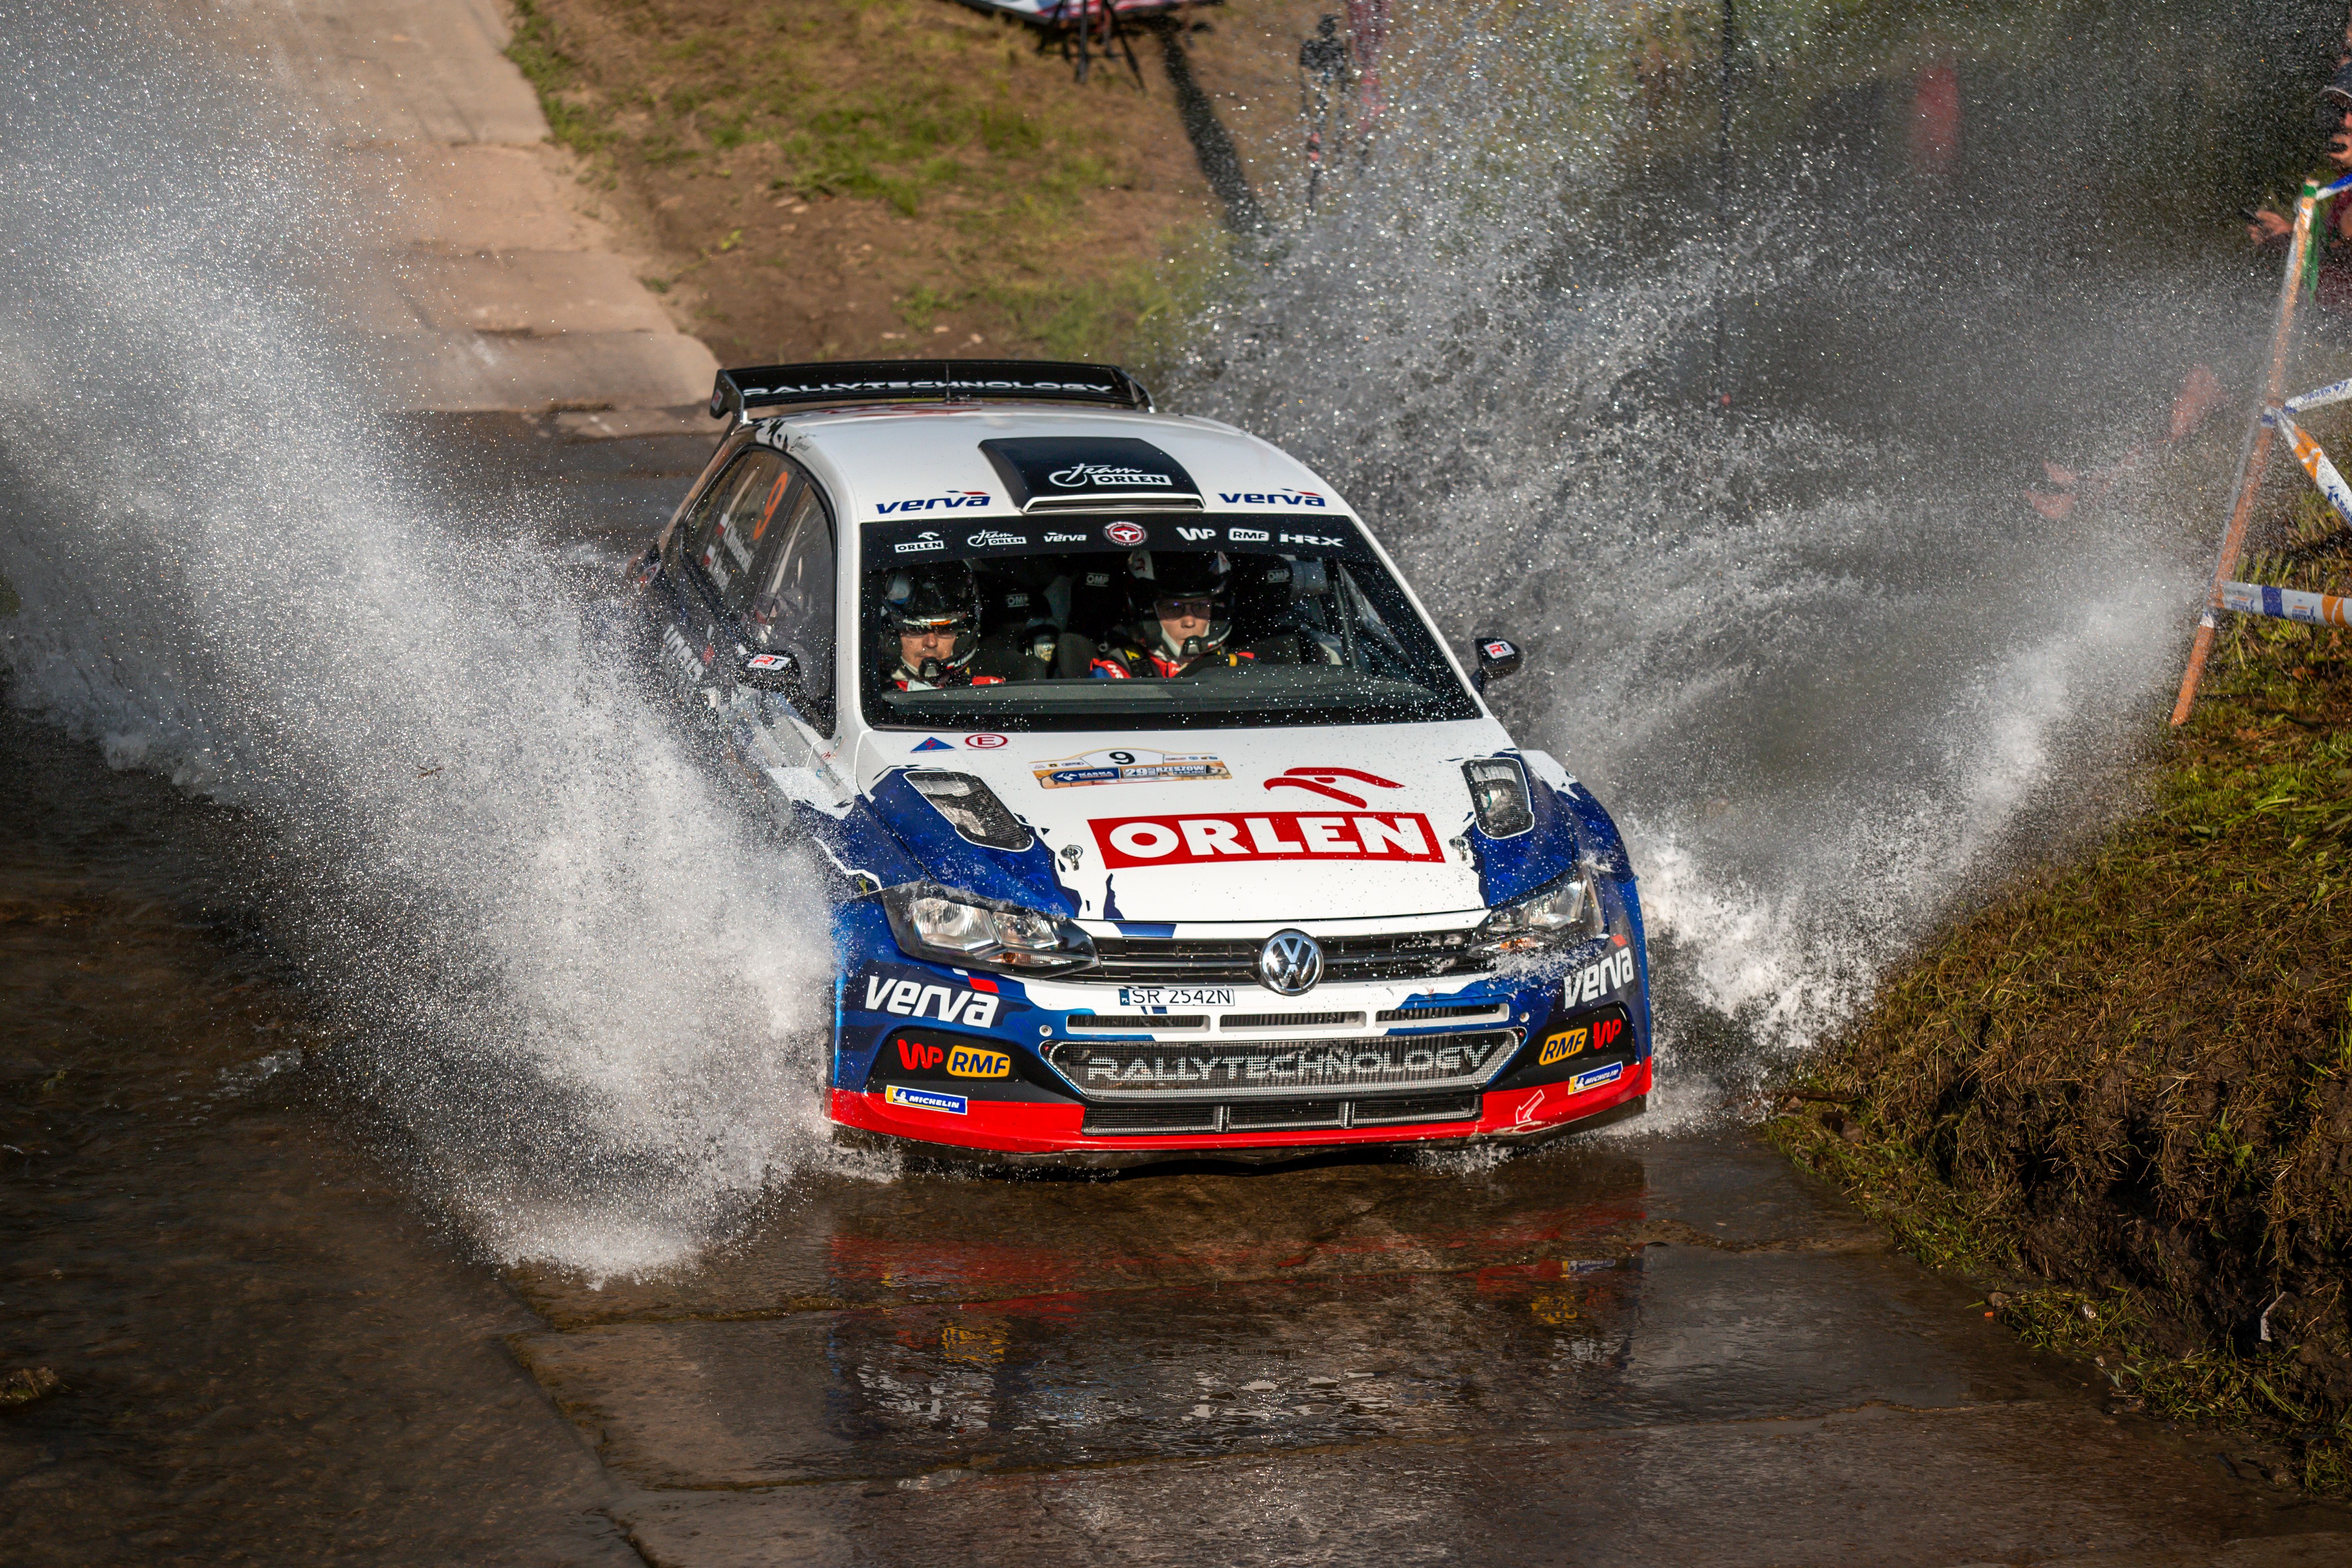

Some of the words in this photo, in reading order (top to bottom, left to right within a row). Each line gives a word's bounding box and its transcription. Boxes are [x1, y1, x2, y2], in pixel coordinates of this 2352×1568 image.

[743, 381, 1113, 397] RALLYTECHNOLOGY
[1049, 463, 1142, 486] team
[753, 472, 787, 540] 9
[875, 493, 991, 514] verva
[1218, 492, 1326, 507] verva
[967, 529, 1014, 546] team
[1044, 534, 1087, 542] verva
[1176, 527, 1217, 541] WP
[1233, 531, 1266, 540] RMF
[1279, 533, 1344, 547] HRX
[897, 542, 942, 551] ORLEN
[1086, 575, 1109, 586] OMP
[977, 736, 996, 746] E
[1109, 752, 1136, 765] 9
[1125, 768, 1147, 777] 29
[1109, 817, 1430, 858] ORLEN
[1563, 947, 1634, 1009] verva
[865, 976, 999, 1028] verva
[1132, 990, 1160, 1003] SR
[1169, 990, 1230, 1004] 2542N
[1543, 1031, 1586, 1061] RMF
[1593, 1019, 1622, 1050] WP
[897, 1039, 943, 1070] WP
[951, 1051, 1009, 1075] RMF
[1088, 1044, 1491, 1080] RALLYTECHNOLOGY
[1585, 1069, 1619, 1085] MICHELIN
[909, 1095, 959, 1109] MICHELIN
